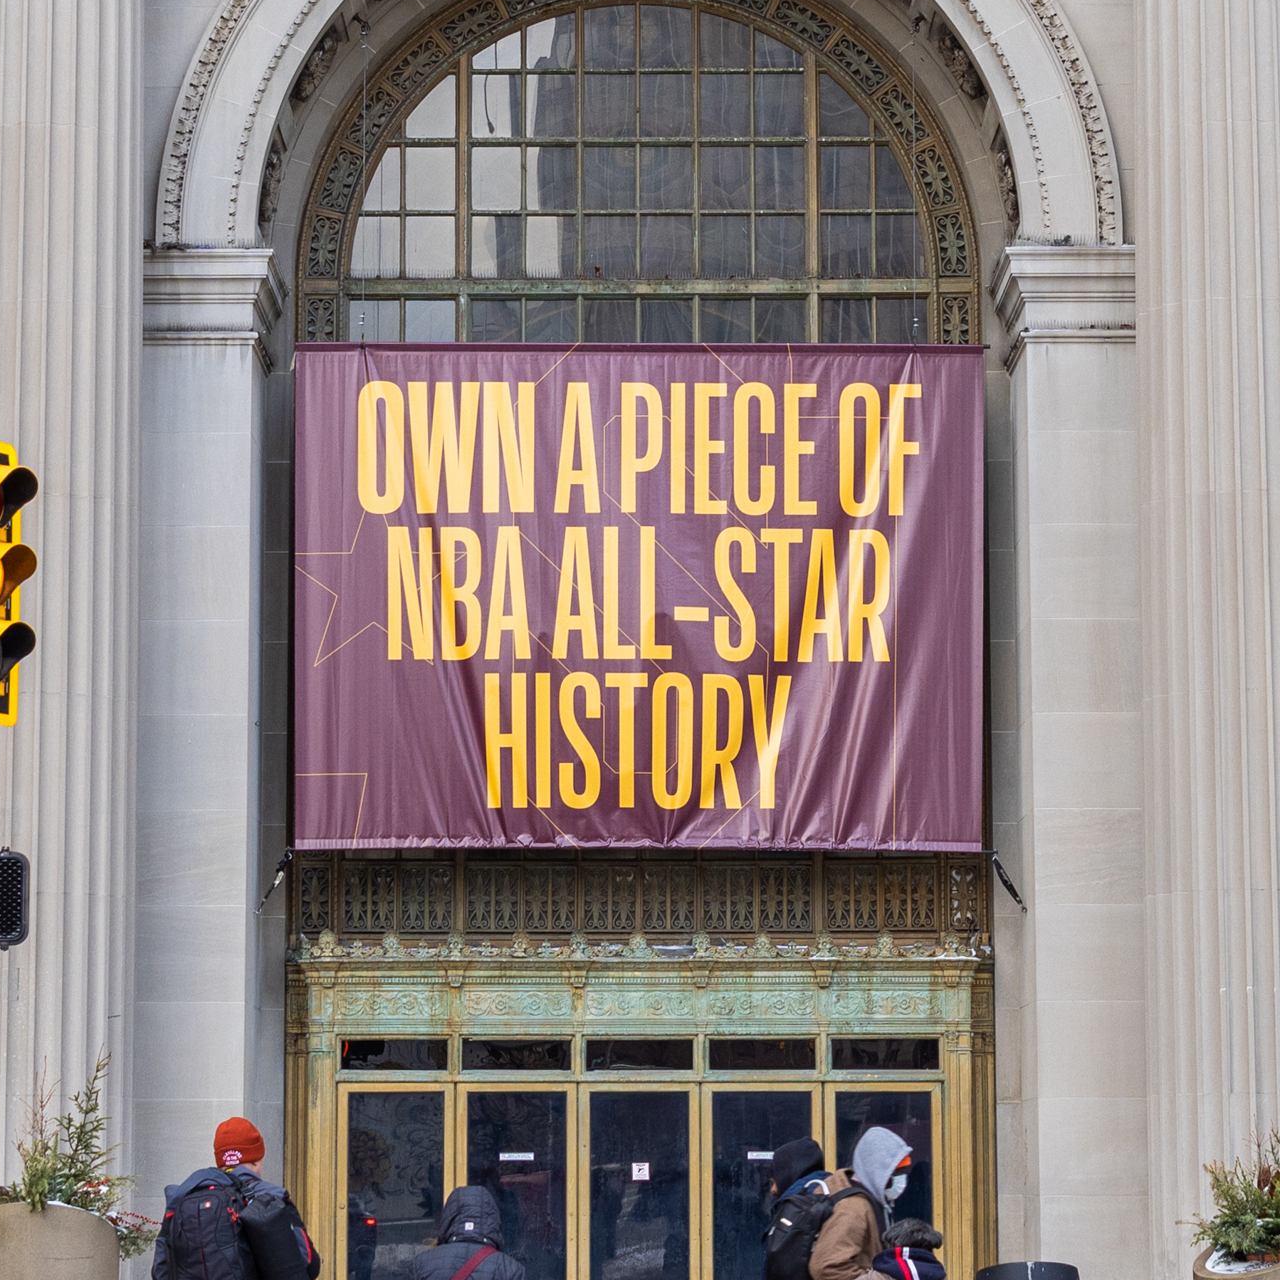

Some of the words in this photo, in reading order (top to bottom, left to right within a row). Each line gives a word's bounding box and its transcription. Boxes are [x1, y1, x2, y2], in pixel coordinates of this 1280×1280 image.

[357, 380, 535, 515] OWN
[553, 381, 601, 515] A
[620, 381, 818, 517] PIECE
[838, 382, 923, 517] OF
[386, 525, 532, 661] NBA
[552, 525, 892, 663] ALL-STAR
[483, 671, 793, 811] HISTORY
